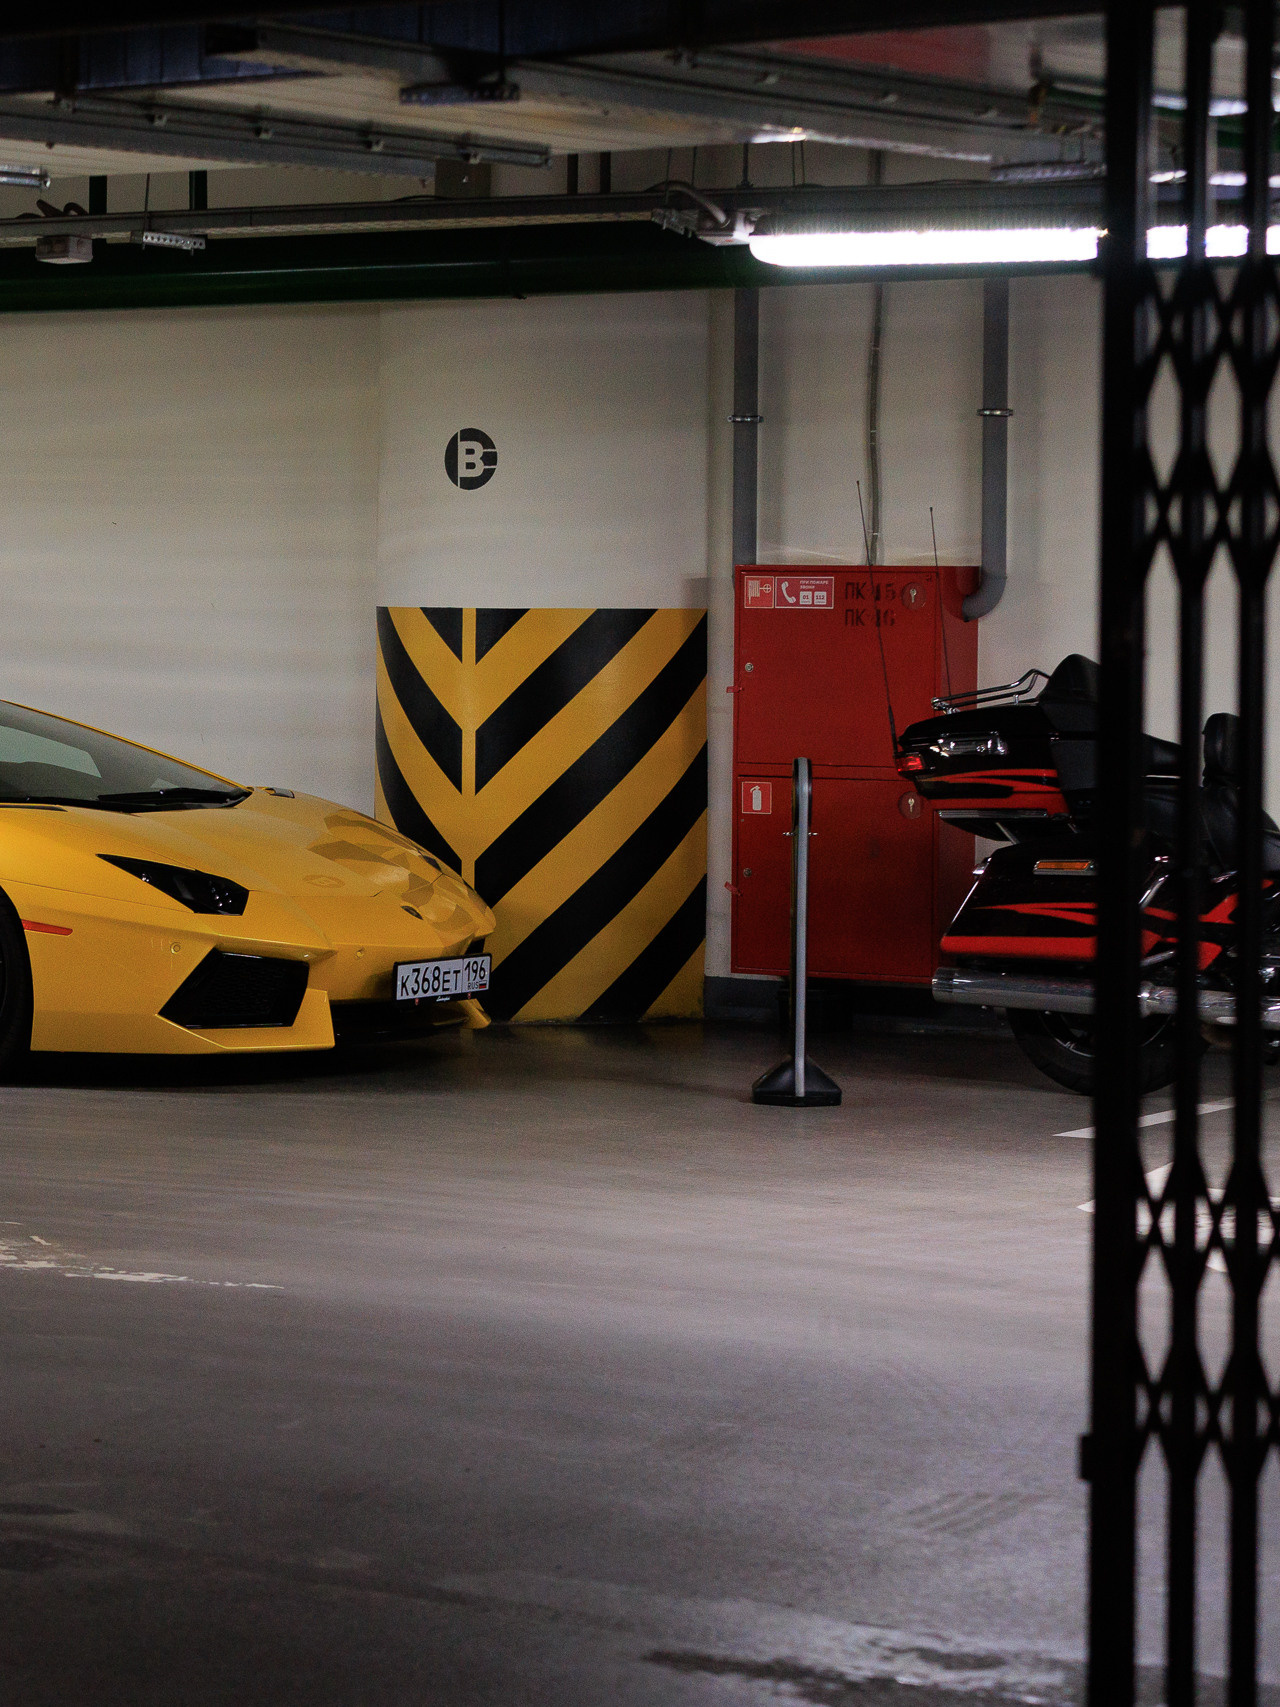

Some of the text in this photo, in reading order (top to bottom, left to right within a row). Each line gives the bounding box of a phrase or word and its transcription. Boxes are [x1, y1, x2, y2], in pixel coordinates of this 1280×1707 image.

[845, 581, 866, 600] ПК
[845, 608, 865, 626] ПК
[464, 959, 486, 982] 196
[467, 981, 479, 991] RUS
